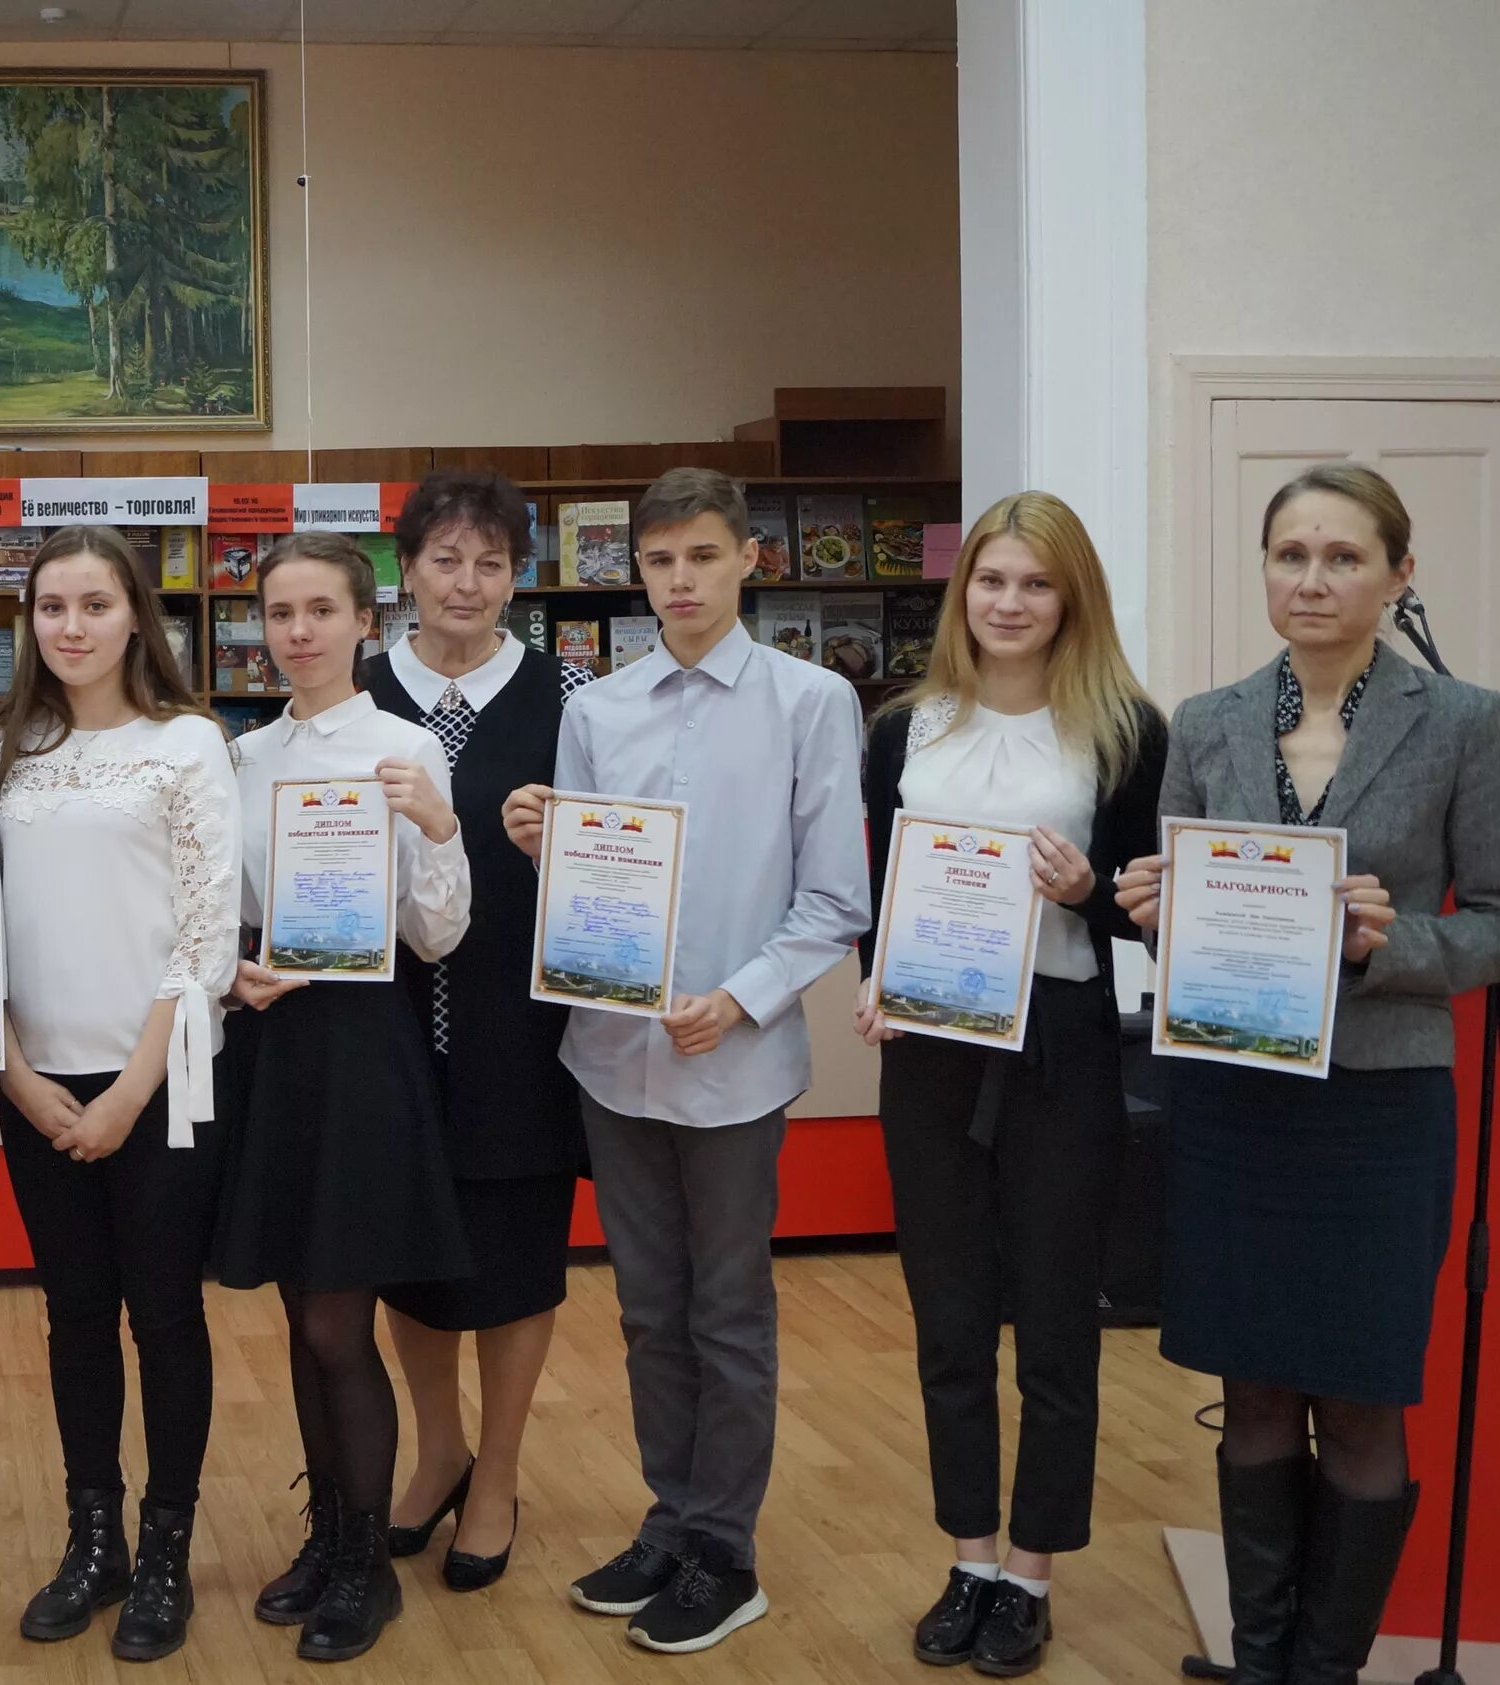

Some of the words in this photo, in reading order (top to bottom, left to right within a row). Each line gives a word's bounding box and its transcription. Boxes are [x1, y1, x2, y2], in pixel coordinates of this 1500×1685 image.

[22, 500, 34, 517] Её
[37, 501, 108, 517] величество
[126, 497, 196, 517] торговля!
[294, 508, 307, 524] Мир
[348, 509, 379, 524] искусства
[314, 820, 352, 829] ДИПЛОМ
[287, 830, 329, 838] победителя
[593, 843, 635, 855] ДИПЛОМ
[564, 850, 609, 862] победителя
[945, 866, 991, 880] ДИПЛОМ
[952, 878, 988, 889] степени
[1205, 879, 1309, 898] БЛАГОДАРНОСТЬ
